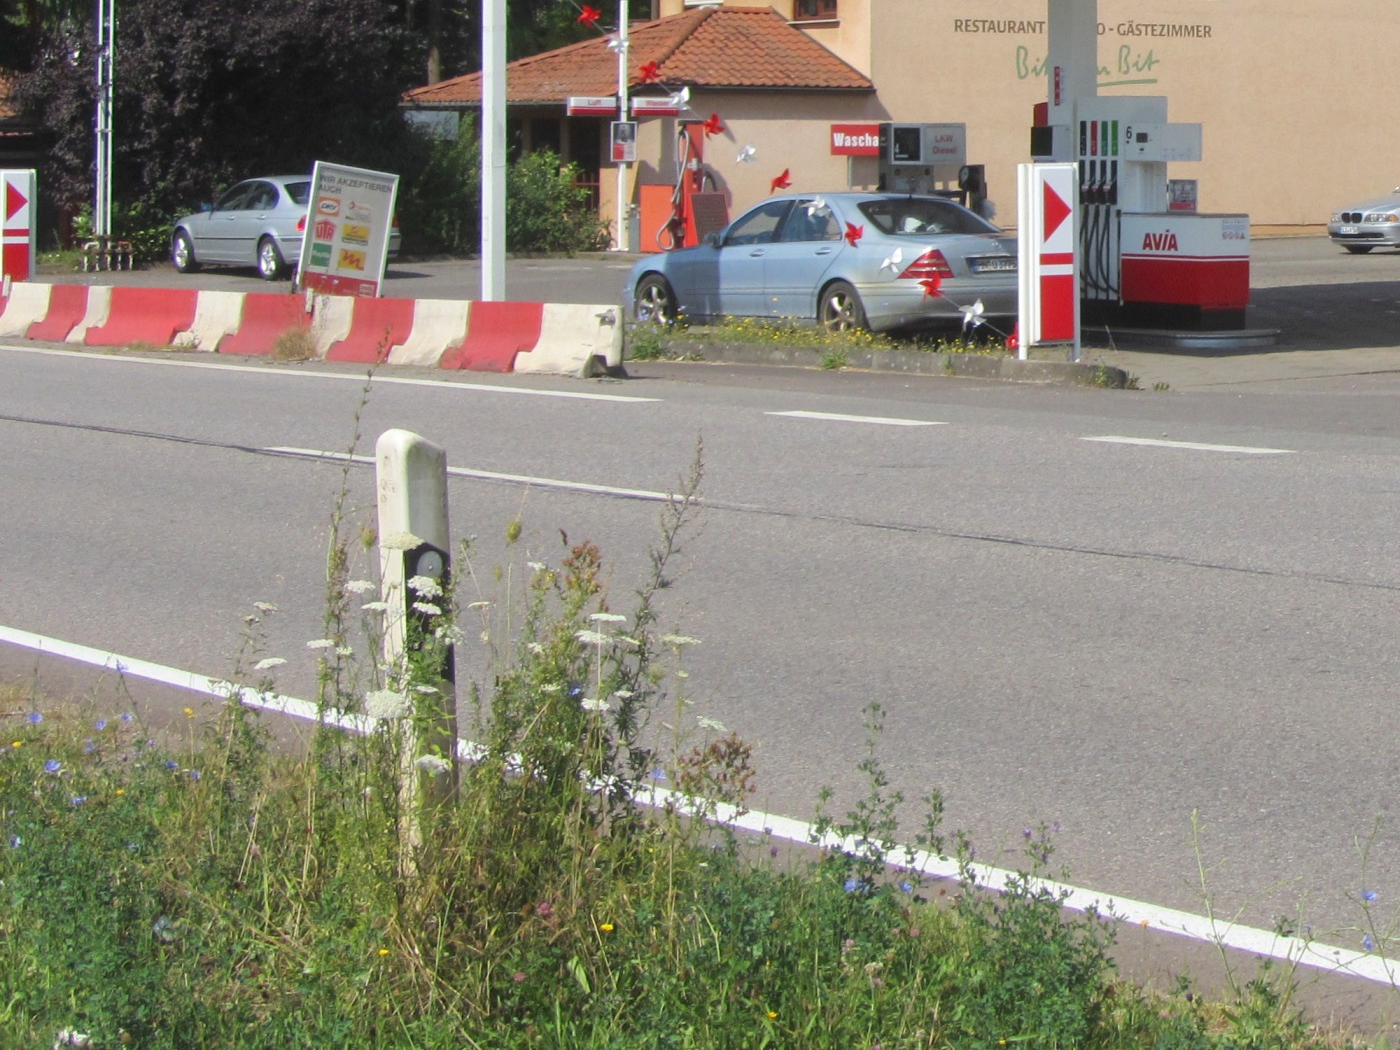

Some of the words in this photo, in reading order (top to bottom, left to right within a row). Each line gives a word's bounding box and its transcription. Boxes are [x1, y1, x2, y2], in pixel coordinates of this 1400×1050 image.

[954, 19, 1046, 35] RESTAURANT
[1117, 21, 1213, 38] GÄSTEZIMMER
[1118, 44, 1160, 76] Bit
[832, 132, 879, 148] Wascha
[1125, 125, 1133, 140] 6
[337, 177, 392, 193] AKZEPTIEREN
